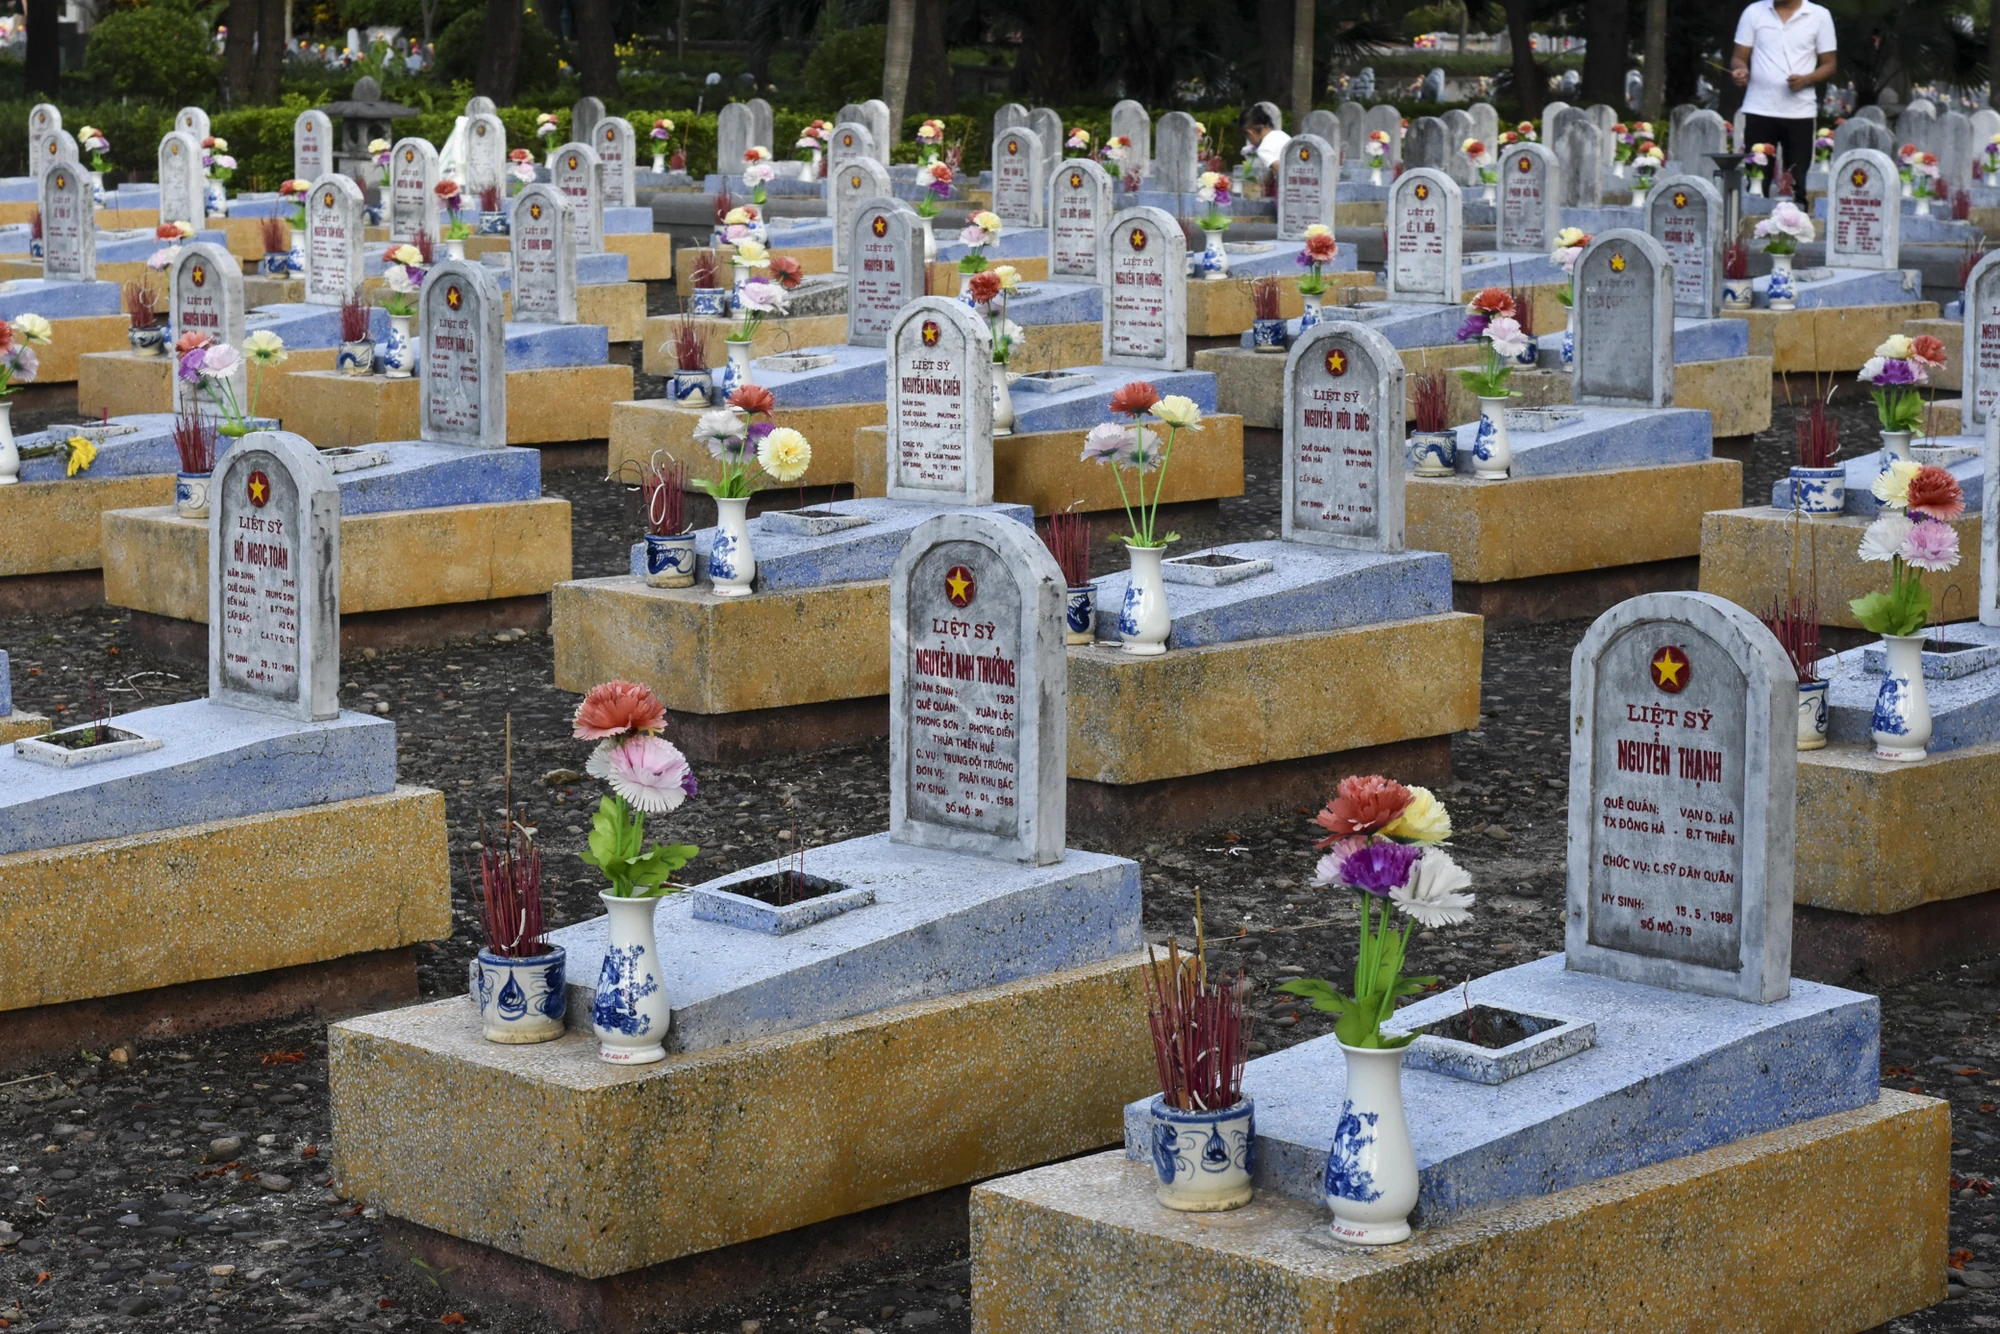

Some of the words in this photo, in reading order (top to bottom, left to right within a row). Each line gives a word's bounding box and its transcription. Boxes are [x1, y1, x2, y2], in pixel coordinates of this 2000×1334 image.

[1123, 257, 1142, 267] LIỆT
[912, 358, 935, 372] LIỆT
[937, 360, 950, 371] SỸ
[1314, 389, 1341, 404] LIỆT
[1344, 391, 1360, 403] SỸ
[1304, 404, 1332, 430] NGUYỄN
[1302, 443, 1313, 451] QUÊ
[239, 515, 265, 533] LIỆT
[268, 519, 283, 535] SỸ
[248, 542, 267, 571] NGỌC
[228, 583, 238, 592] QUÊ
[228, 595, 238, 606] BẾN
[933, 617, 970, 640] LIỆT
[975, 621, 996, 640] SỸ
[227, 653, 234, 661] HY
[916, 641, 953, 678] NGUYỄN
[956, 654, 975, 681] ANH
[247, 669, 254, 678] SỐ
[997, 694, 1014, 704] 1928
[916, 698, 931, 710] QUÊ
[933, 702, 959, 713] QUÁN:
[976, 707, 997, 718] XUÂN
[999, 709, 1013, 723] LỘC
[1627, 703, 1678, 730] LIỆT
[1684, 709, 1713, 731] SỸ
[917, 716, 941, 727] PHONG
[943, 720, 958, 730] SƠN
[969, 723, 994, 735] PHONG
[996, 725, 1014, 739] ĐIỀN
[933, 732, 953, 747] THỪA
[956, 738, 977, 750] THIÊN
[980, 740, 995, 753] HUẾ
[944, 753, 967, 765] TRUNG
[969, 755, 982, 767] ĐỘI
[984, 759, 1013, 773] TRƯỞNG
[1617, 733, 1670, 776] NGUYỄN
[1678, 747, 1722, 788] THẠNH
[916, 765, 933, 776] ĐƠN
[981, 777, 996, 787] KHU
[998, 778, 1013, 790] BẮC
[917, 783, 926, 791] HY
[928, 784, 949, 796] SINH:
[946, 802, 956, 813] SỐ
[1604, 797, 1625, 813] QUÊ
[1627, 799, 1659, 814] QUÁN:
[1719, 810, 1735, 825] HÀ
[1603, 816, 1617, 829] TX
[1619, 817, 1648, 832] ĐÔNG
[1652, 820, 1666, 835] HÀ
[1705, 829, 1735, 845] THIÊN
[1603, 852, 1631, 870] CHỨC
[1633, 861, 1650, 872] VỤ:
[1679, 865, 1701, 880] DÂN
[1704, 869, 1734, 883] QUÂN
[1602, 893, 1615, 906] HY
[1618, 896, 1644, 909] SINH:
[1640, 917, 1655, 931] SỐ
